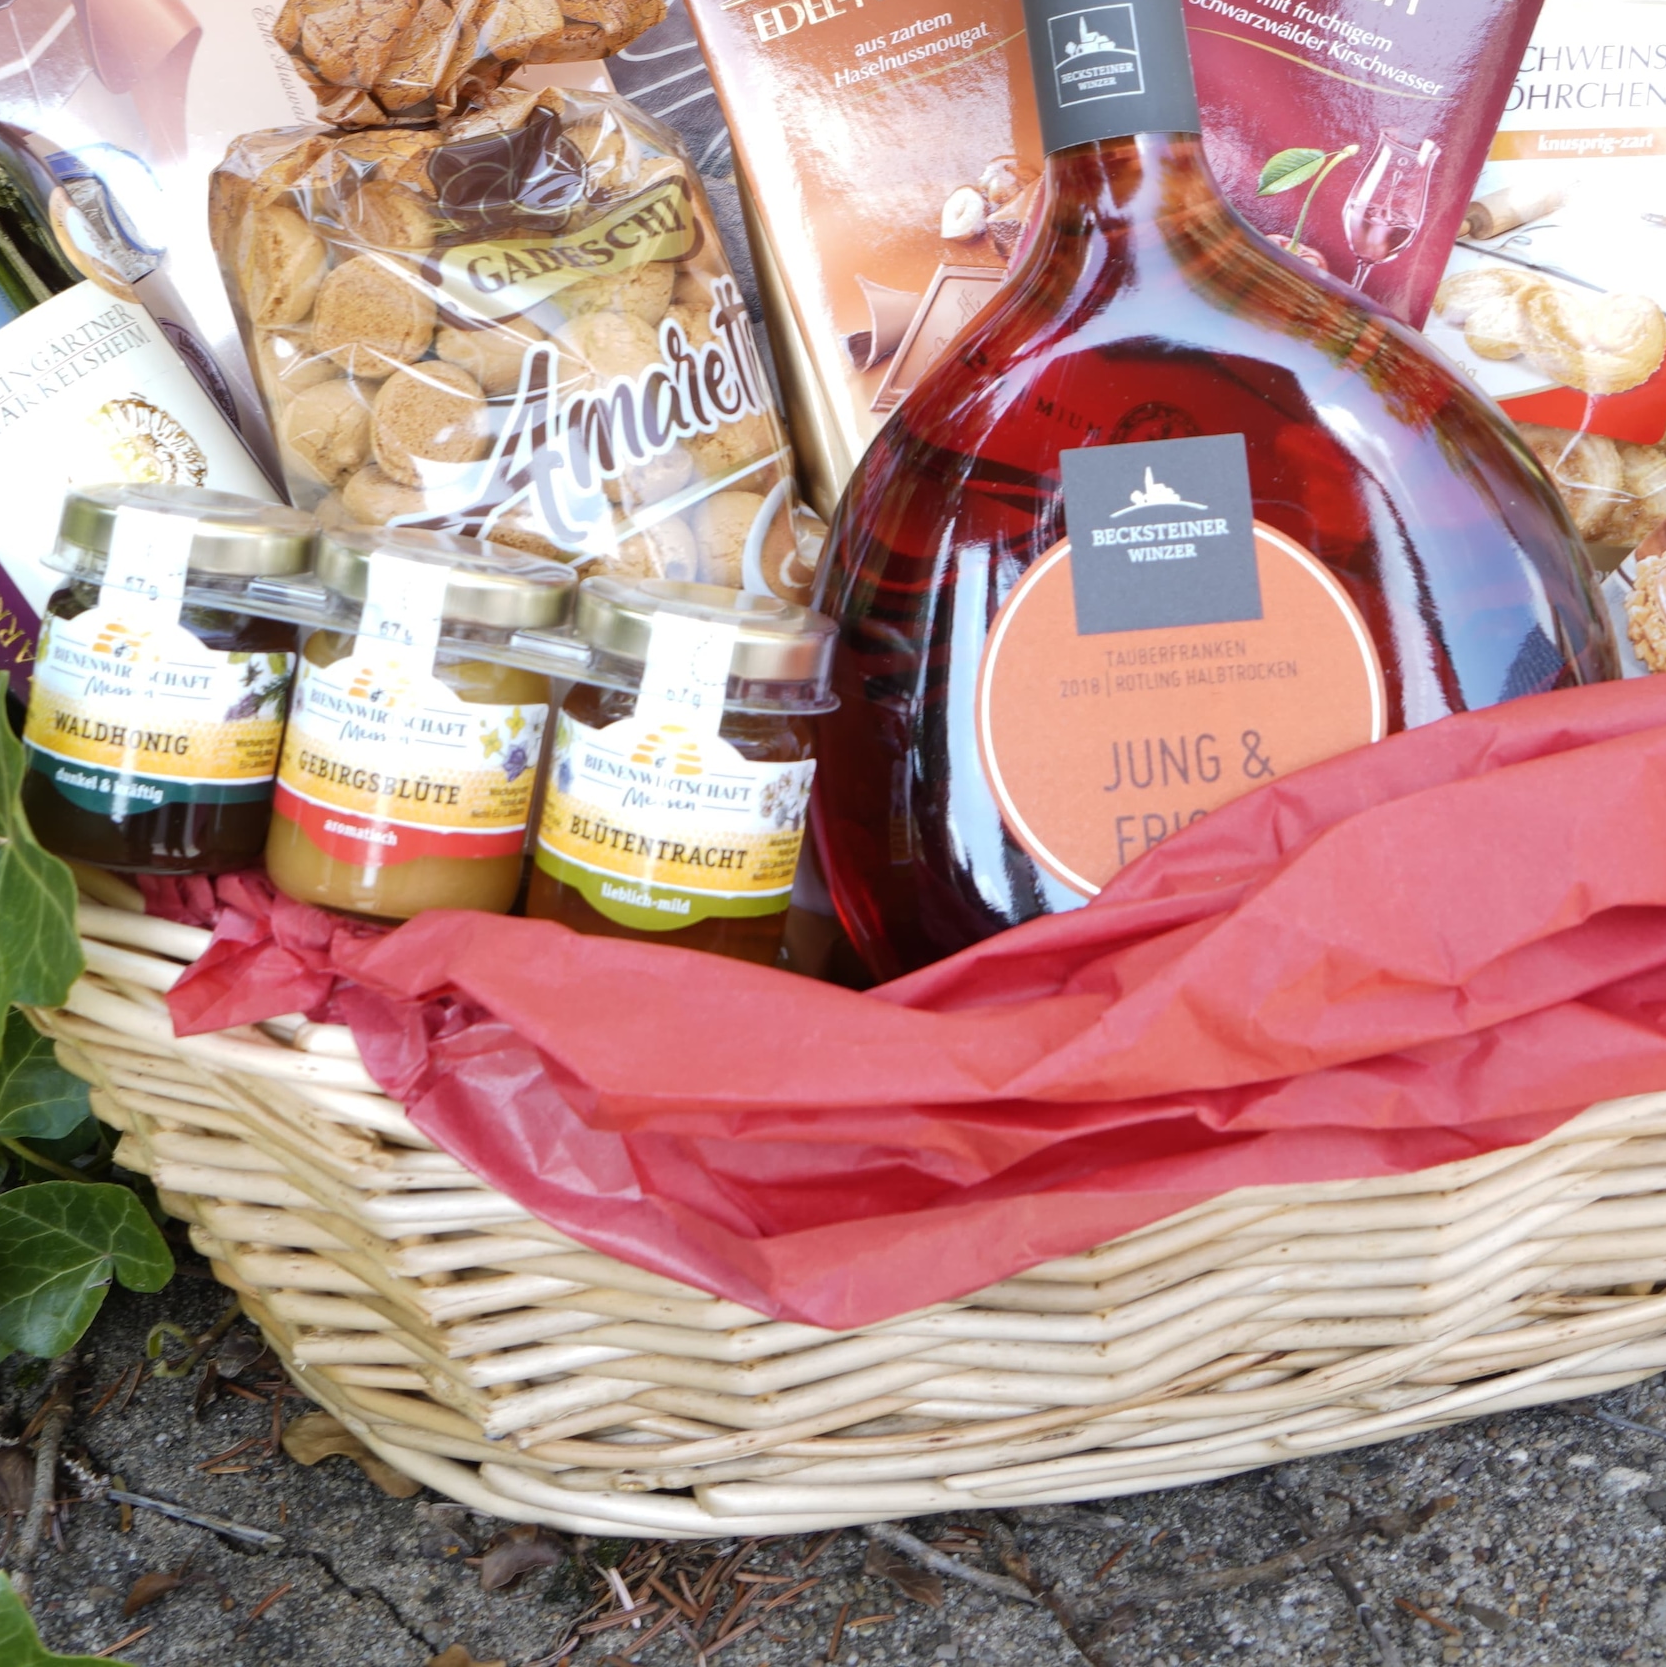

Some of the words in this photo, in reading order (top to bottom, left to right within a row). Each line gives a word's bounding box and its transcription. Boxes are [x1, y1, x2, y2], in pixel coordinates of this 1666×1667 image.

[855, 33, 886, 57] aus
[891, 13, 952, 45] zartem
[1292, 2, 1392, 52] fruchtigem
[834, 22, 989, 88] Haselnussnougat
[1061, 62, 1135, 84] BECKSTEINER
[1328, 41, 1443, 96] Kirschwasser
[1077, 77, 1117, 90] WINZER
[1537, 133, 1654, 155] knusprig-zart
[467, 193, 687, 294] GADESCHI
[1091, 518, 1230, 547] BECKSTEINER
[1128, 543, 1198, 563] WINZER
[1105, 640, 1247, 667] TAUBERFRANKEN
[1060, 677, 1101, 698] 2018
[1116, 670, 1181, 693] ROTLING
[1186, 660, 1298, 685] HALBTROCKEN
[54, 710, 190, 755] WALDHONIG
[299, 750, 462, 805] GEBIRGSBLÜTE
[1103, 733, 1221, 792] JUNG
[1240, 730, 1275, 779] &
[55, 767, 97, 791] dunkel
[99, 777, 111, 793] &
[112, 780, 164, 804] kräftig
[323, 819, 398, 846] aromatisch
[570, 815, 749, 869] BLÜTENTRACHT
[601, 881, 691, 914] lieblich-mild
